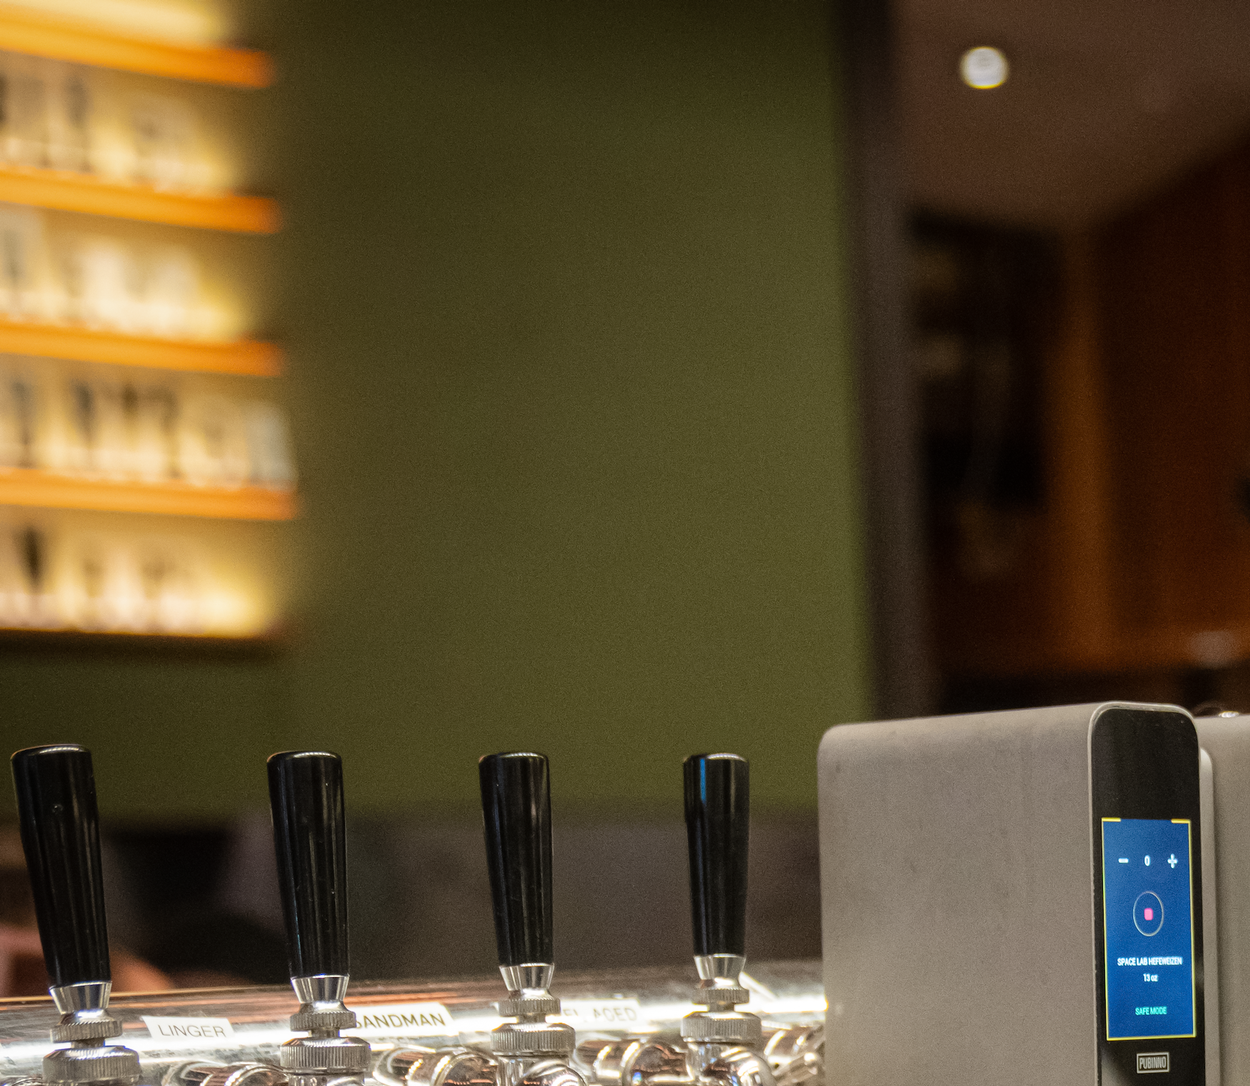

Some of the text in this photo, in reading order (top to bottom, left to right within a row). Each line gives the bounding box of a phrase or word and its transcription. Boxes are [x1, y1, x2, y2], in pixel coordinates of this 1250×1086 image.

[1144, 855, 1151, 867] 0
[1117, 957, 1136, 966] SPACE
[1137, 956, 1148, 966] LAB
[1143, 973, 1159, 982] 13 oz
[1135, 1006, 1167, 1016] SAFE MODE
[158, 1024, 227, 1038] LINGER
[1139, 1056, 1167, 1070] PUBINNO
